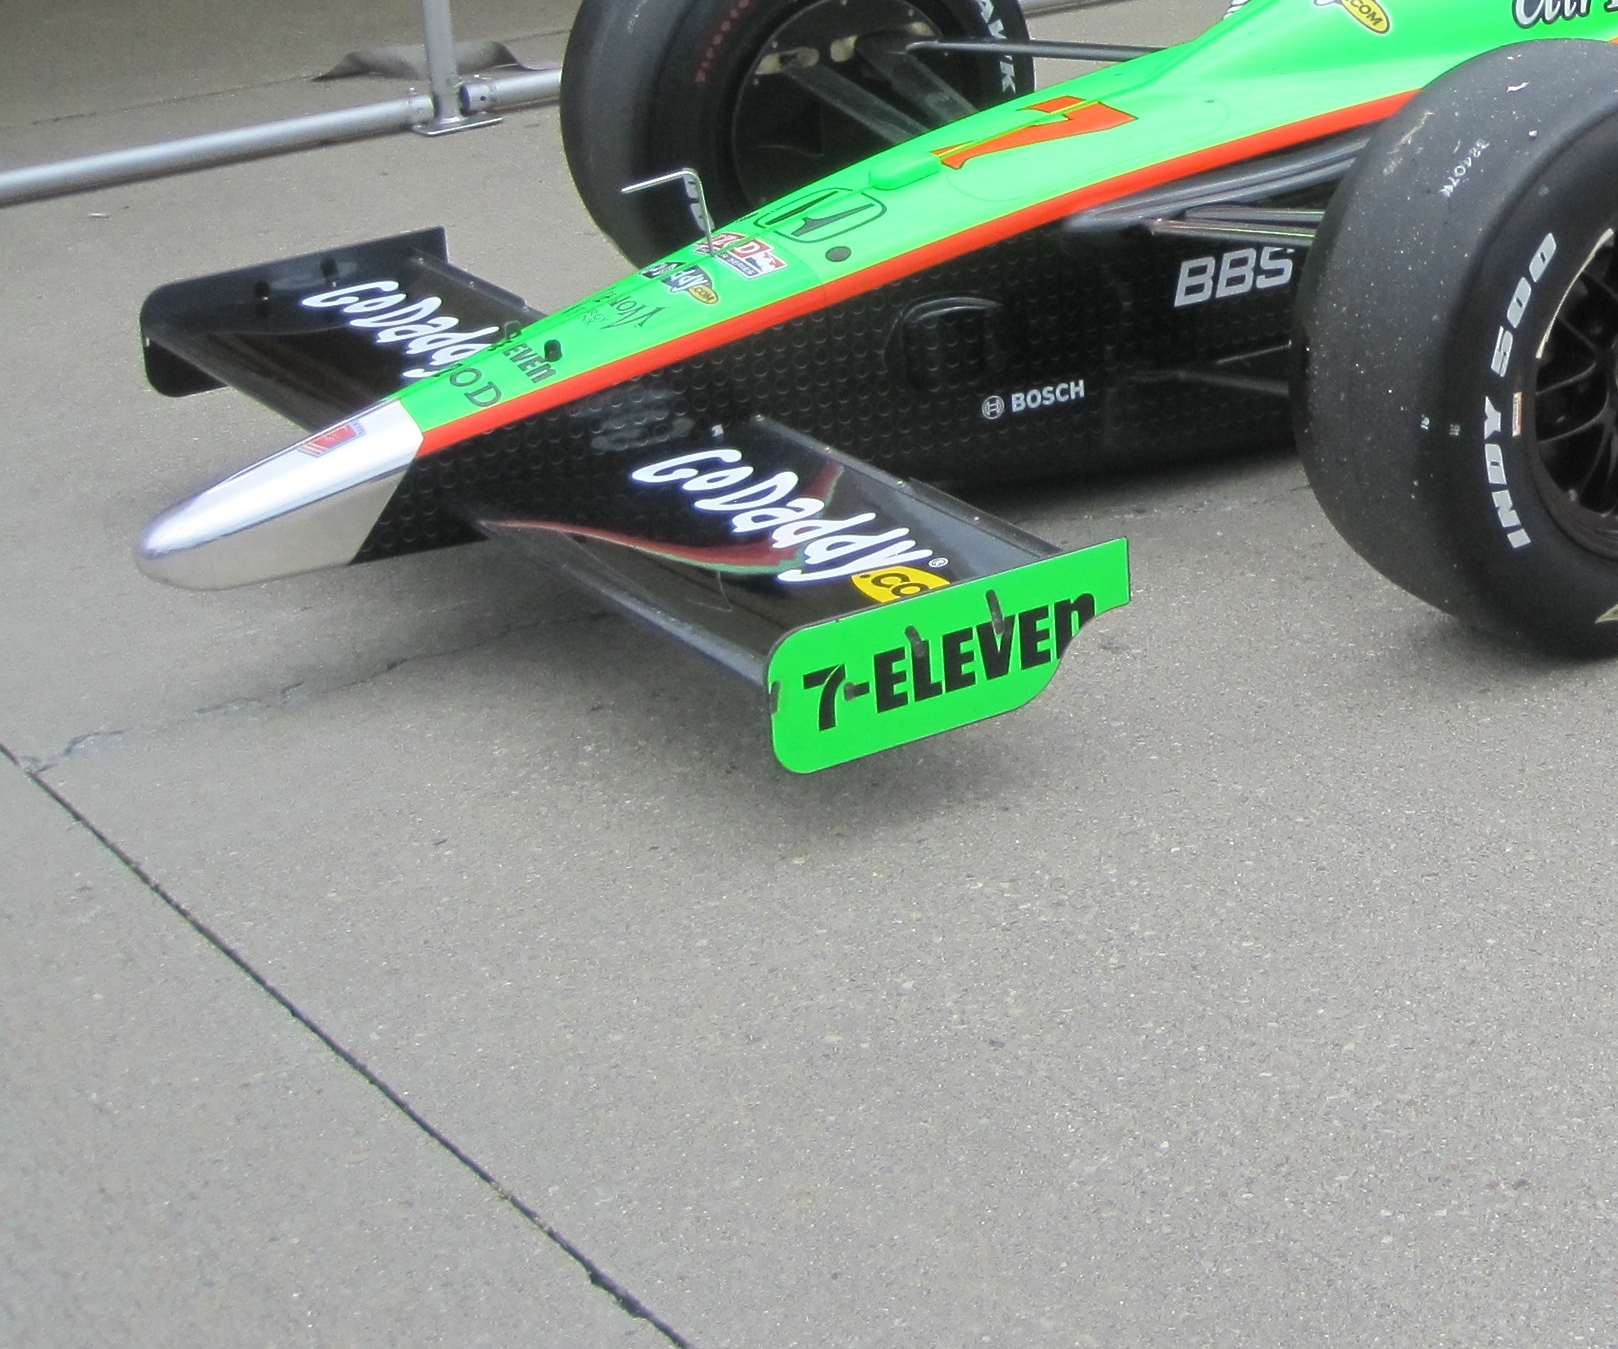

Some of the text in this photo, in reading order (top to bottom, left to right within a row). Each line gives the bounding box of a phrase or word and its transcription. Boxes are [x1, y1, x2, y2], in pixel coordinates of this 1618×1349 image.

[934, 95, 1139, 170] 7
[1174, 246, 1295, 308] BBS
[1011, 379, 1086, 413] BOSCH
[630, 448, 933, 599] GoDaddy .CO
